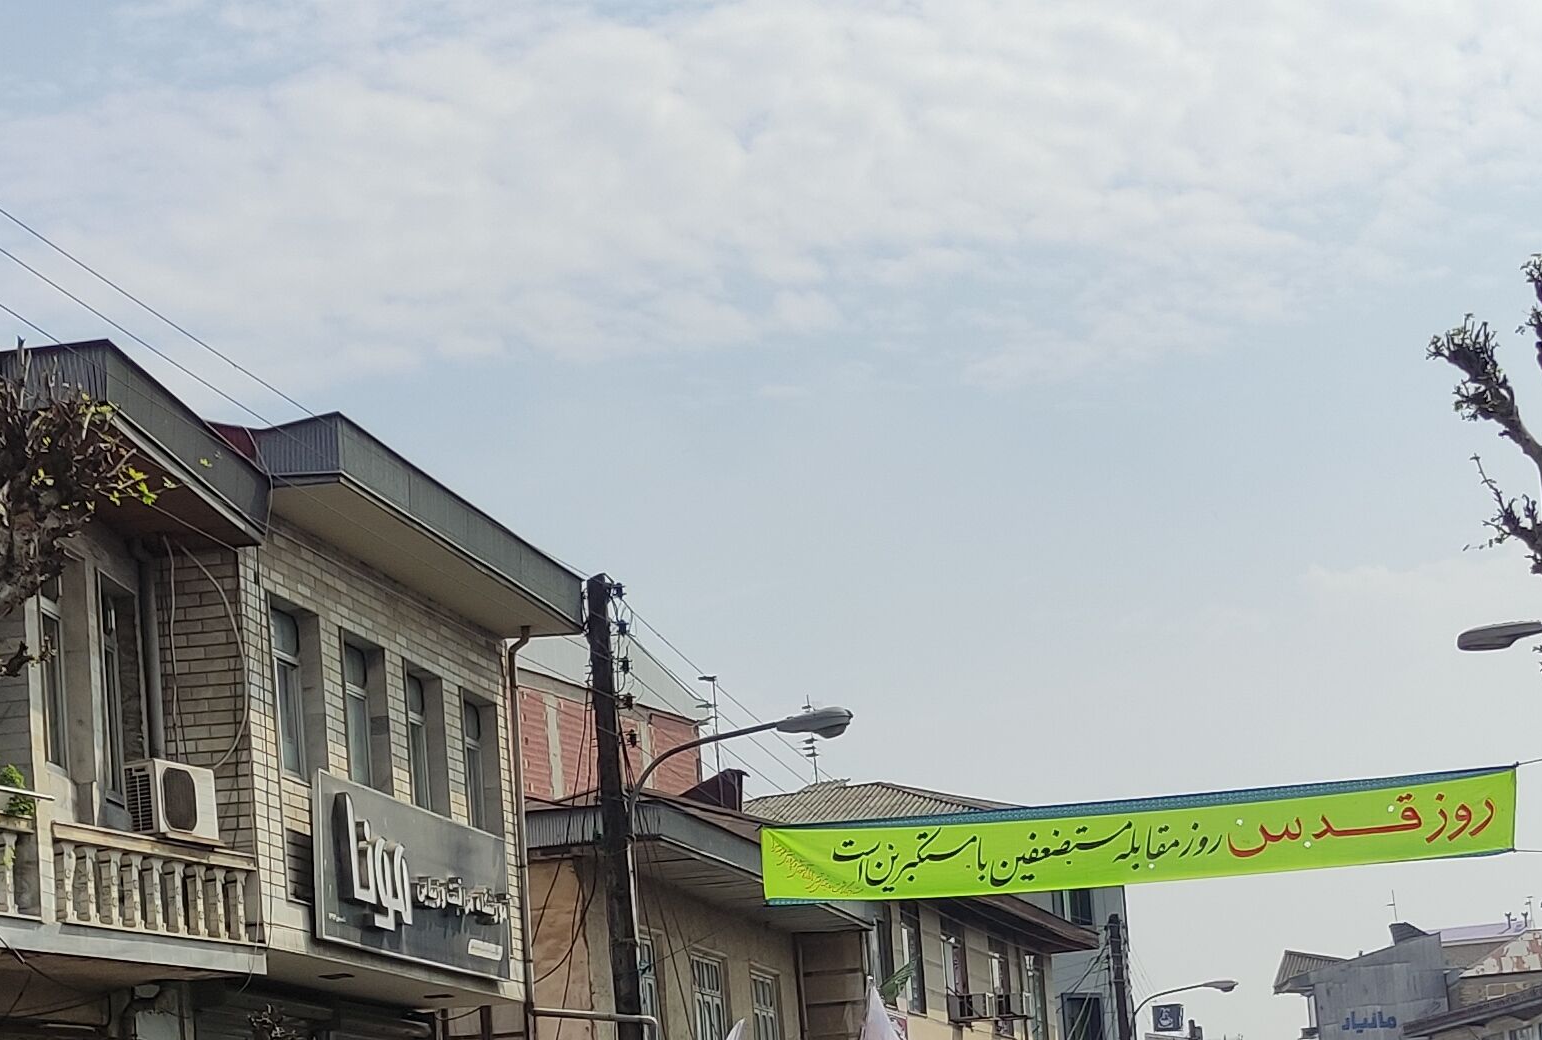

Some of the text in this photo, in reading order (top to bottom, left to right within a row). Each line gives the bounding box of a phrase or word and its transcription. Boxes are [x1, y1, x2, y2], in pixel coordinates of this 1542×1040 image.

[1178, 822, 1222, 858] روز
[1227, 793, 1422, 858] قدس
[1425, 793, 1495, 843] روز
[832, 838, 882, 882] است
[865, 827, 977, 892] مستکبرین
[976, 837, 987, 881] با
[1112, 825, 1180, 870] مقابله
